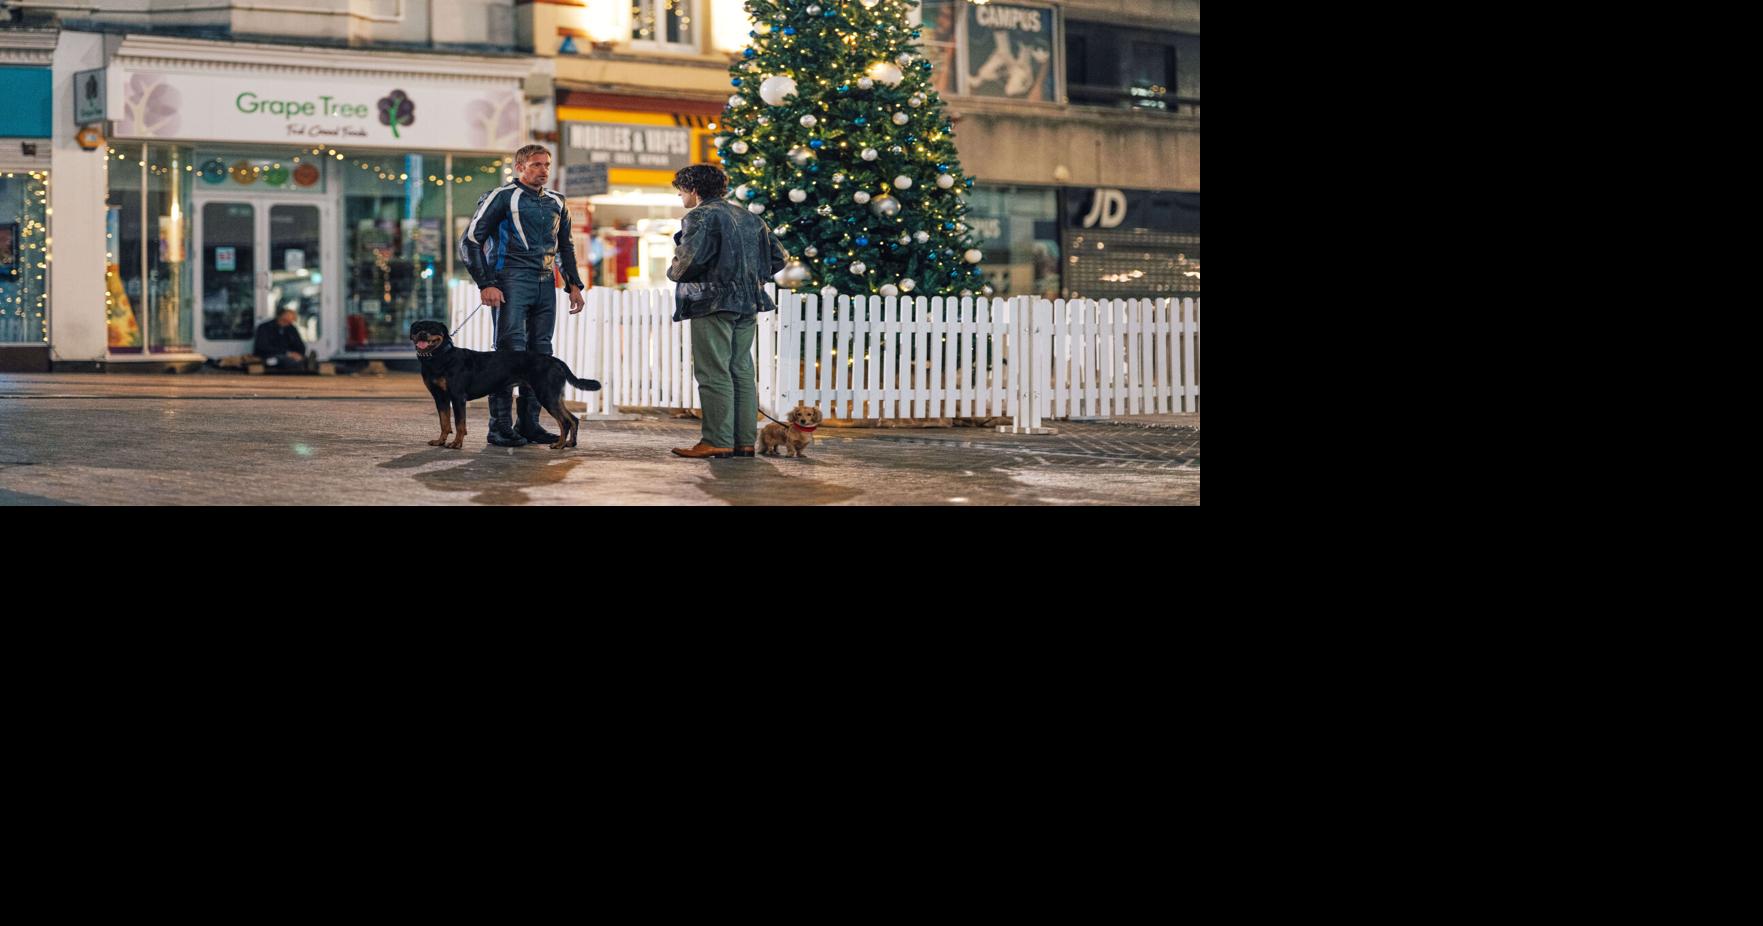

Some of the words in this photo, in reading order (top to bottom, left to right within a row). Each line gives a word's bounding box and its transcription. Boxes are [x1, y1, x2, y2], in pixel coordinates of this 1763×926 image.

[975, 5, 1041, 32] CAMPUS
[236, 92, 315, 119] Grape
[319, 96, 368, 118] Tree
[633, 130, 644, 153] &
[1083, 188, 1127, 228] JD
